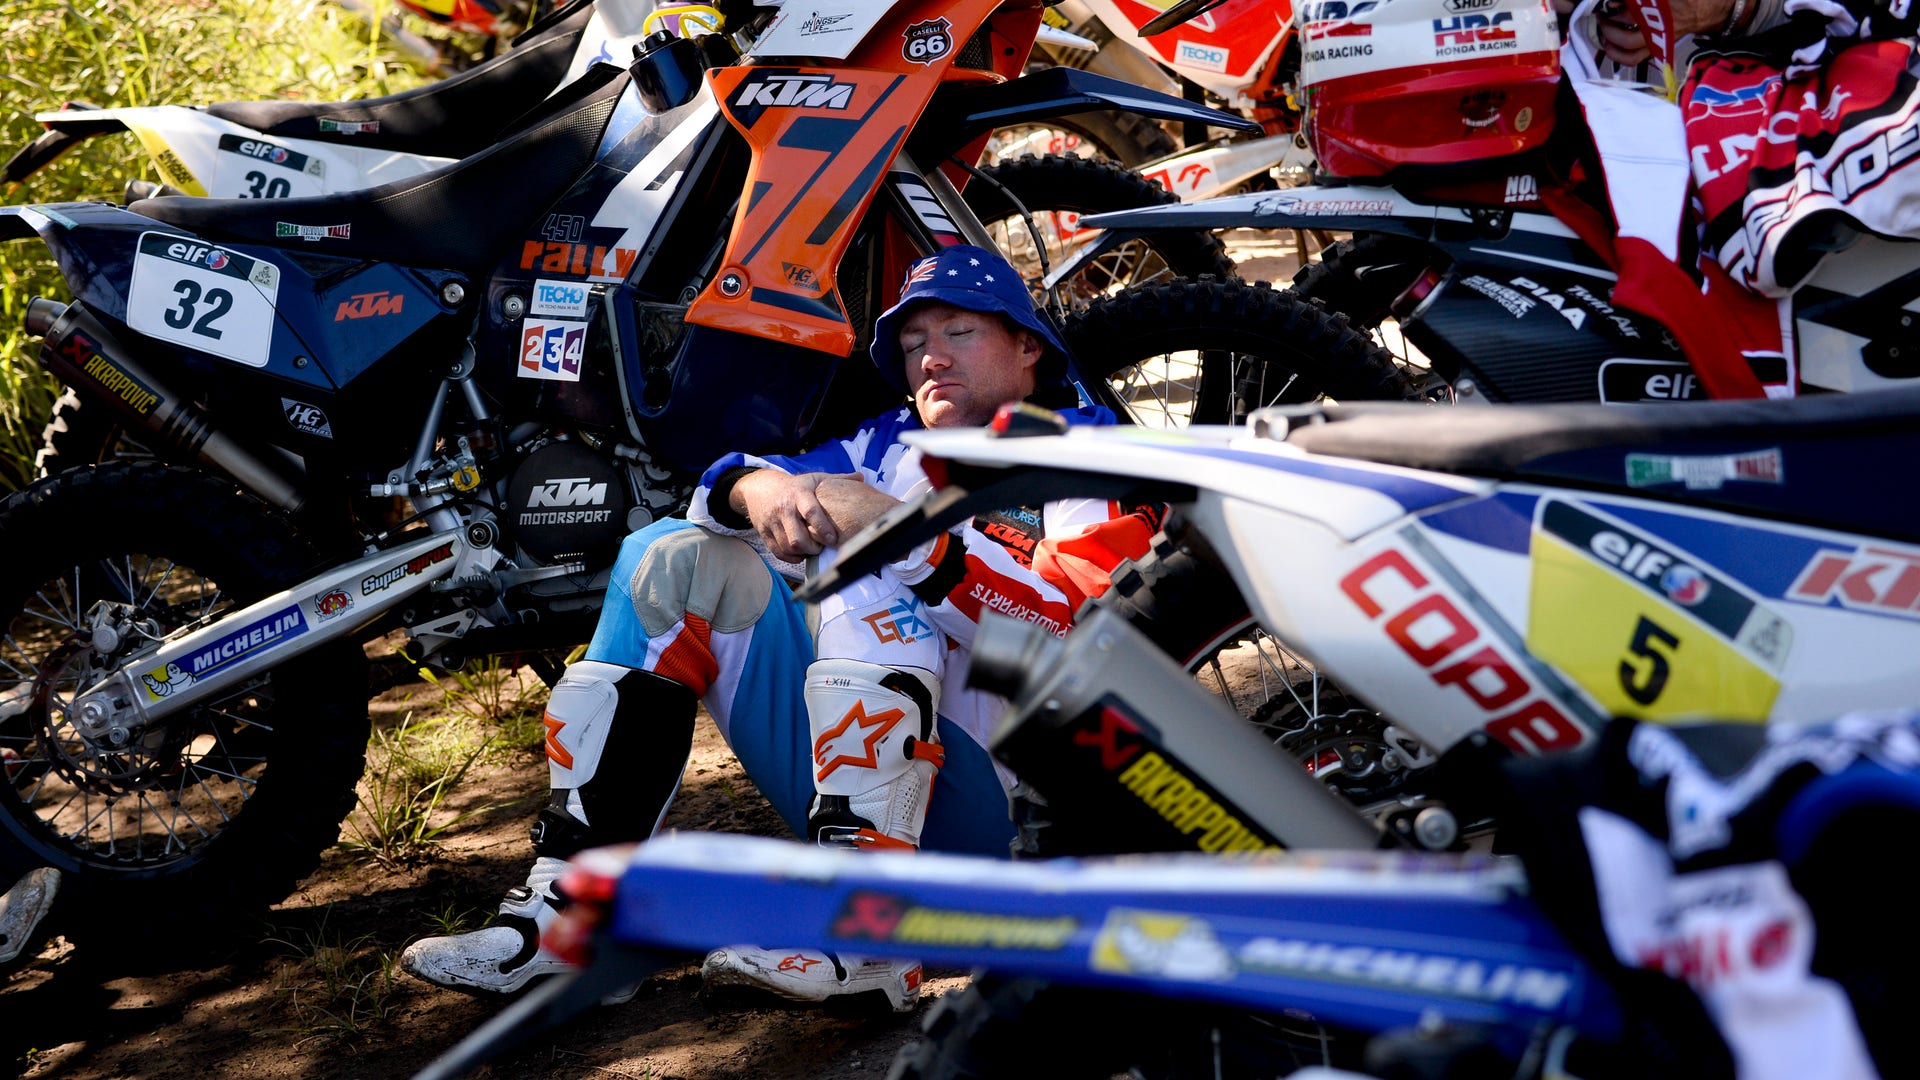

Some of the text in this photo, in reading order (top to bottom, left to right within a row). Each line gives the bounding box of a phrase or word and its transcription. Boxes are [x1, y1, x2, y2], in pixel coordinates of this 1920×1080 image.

[912, 26, 941, 37] CASELLI
[1432, 12, 1516, 47] HRC
[909, 35, 945, 57] 66
[1328, 44, 1373, 60] RACING
[1436, 40, 1517, 57] HONDA RACING
[736, 75, 854, 109] KTM
[239, 141, 271, 158] elf
[239, 170, 291, 199] 30
[1292, 199, 1394, 213] RENTHAL
[328, 223, 350, 239] VALLE
[541, 213, 585, 243] 450
[167, 243, 208, 261] elf
[787, 266, 812, 284] HG
[334, 290, 404, 322] KTM
[538, 285, 584, 304] TECHO
[1510, 276, 1587, 331] PIAA
[164, 279, 233, 341] 32
[1645, 373, 1696, 399] elf
[290, 405, 321, 427] HG
[526, 477, 607, 508] KTM
[519, 510, 612, 525] MOTORSPORT
[997, 505, 1041, 528] OTOREX
[984, 522, 1035, 552] KTM
[1590, 530, 1673, 580] elf
[1797, 546, 1920, 613] KT
[193, 610, 300, 672] MICHELIN
[1618, 615, 1681, 706] 5
[1118, 751, 1282, 853] AKRAPOV
[1238, 936, 1572, 1006] MICHELIN
